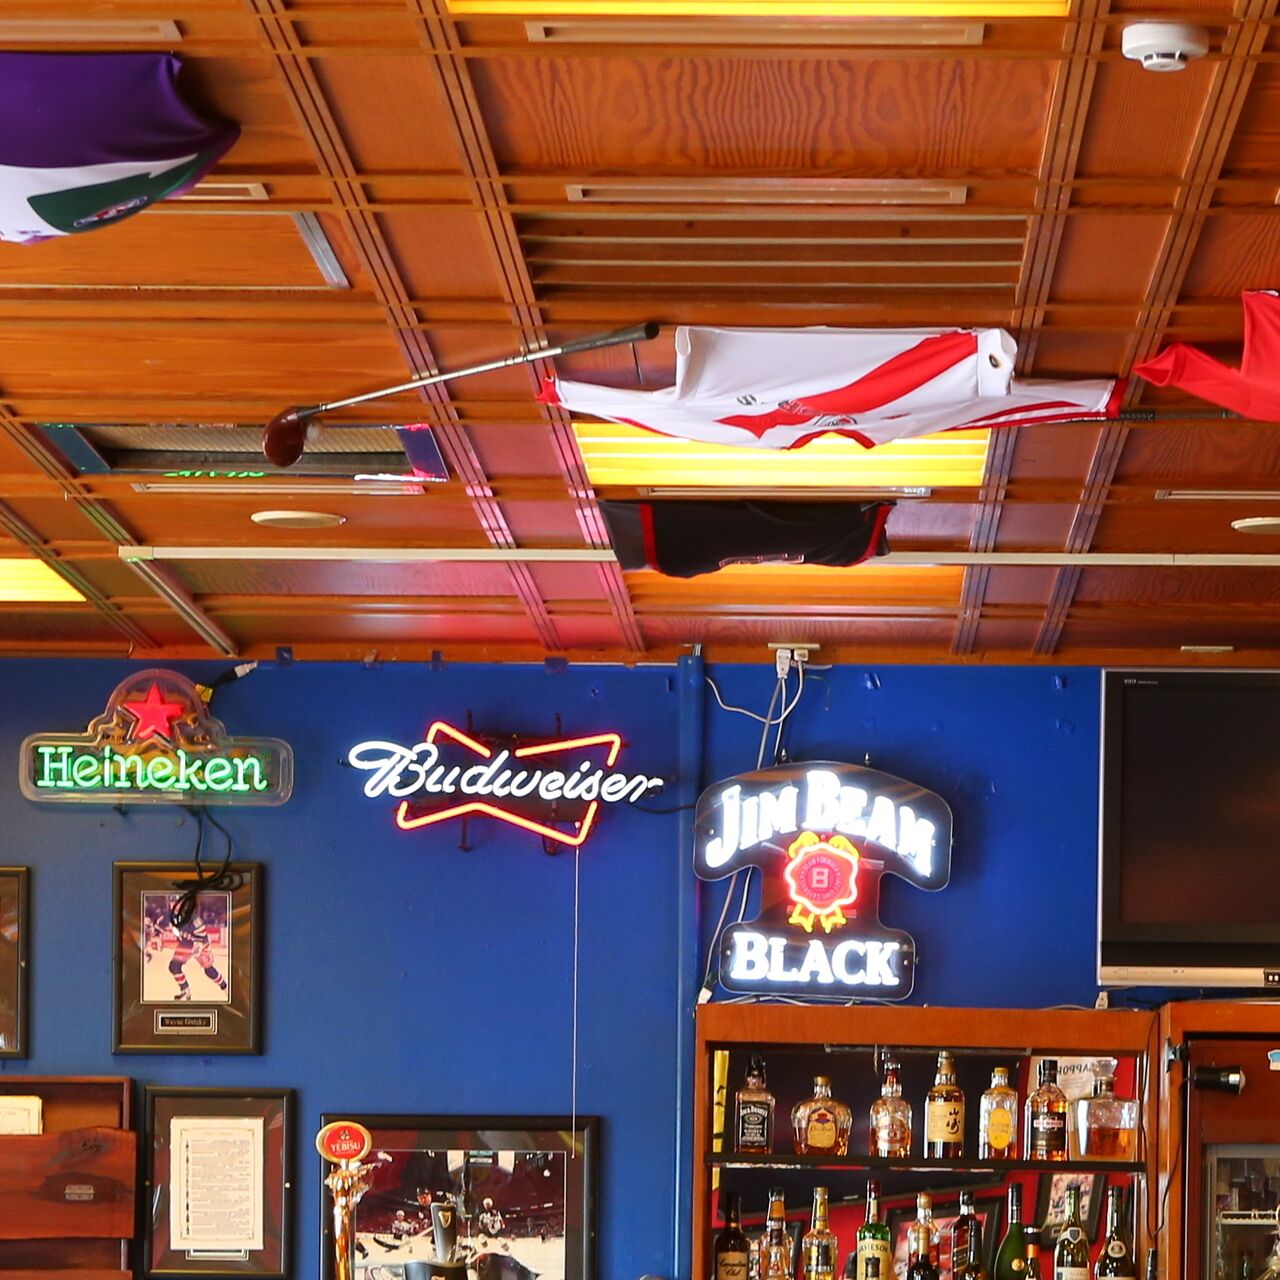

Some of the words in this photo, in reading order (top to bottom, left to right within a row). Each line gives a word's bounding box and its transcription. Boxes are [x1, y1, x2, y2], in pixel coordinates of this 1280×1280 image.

[36, 745, 267, 791] Heineken
[349, 741, 664, 803] Budweiser
[705, 784, 799, 868] JIM
[800, 770, 936, 878] BEAM
[730, 931, 900, 985] BLACK
[330, 1142, 361, 1152] YEBISU
